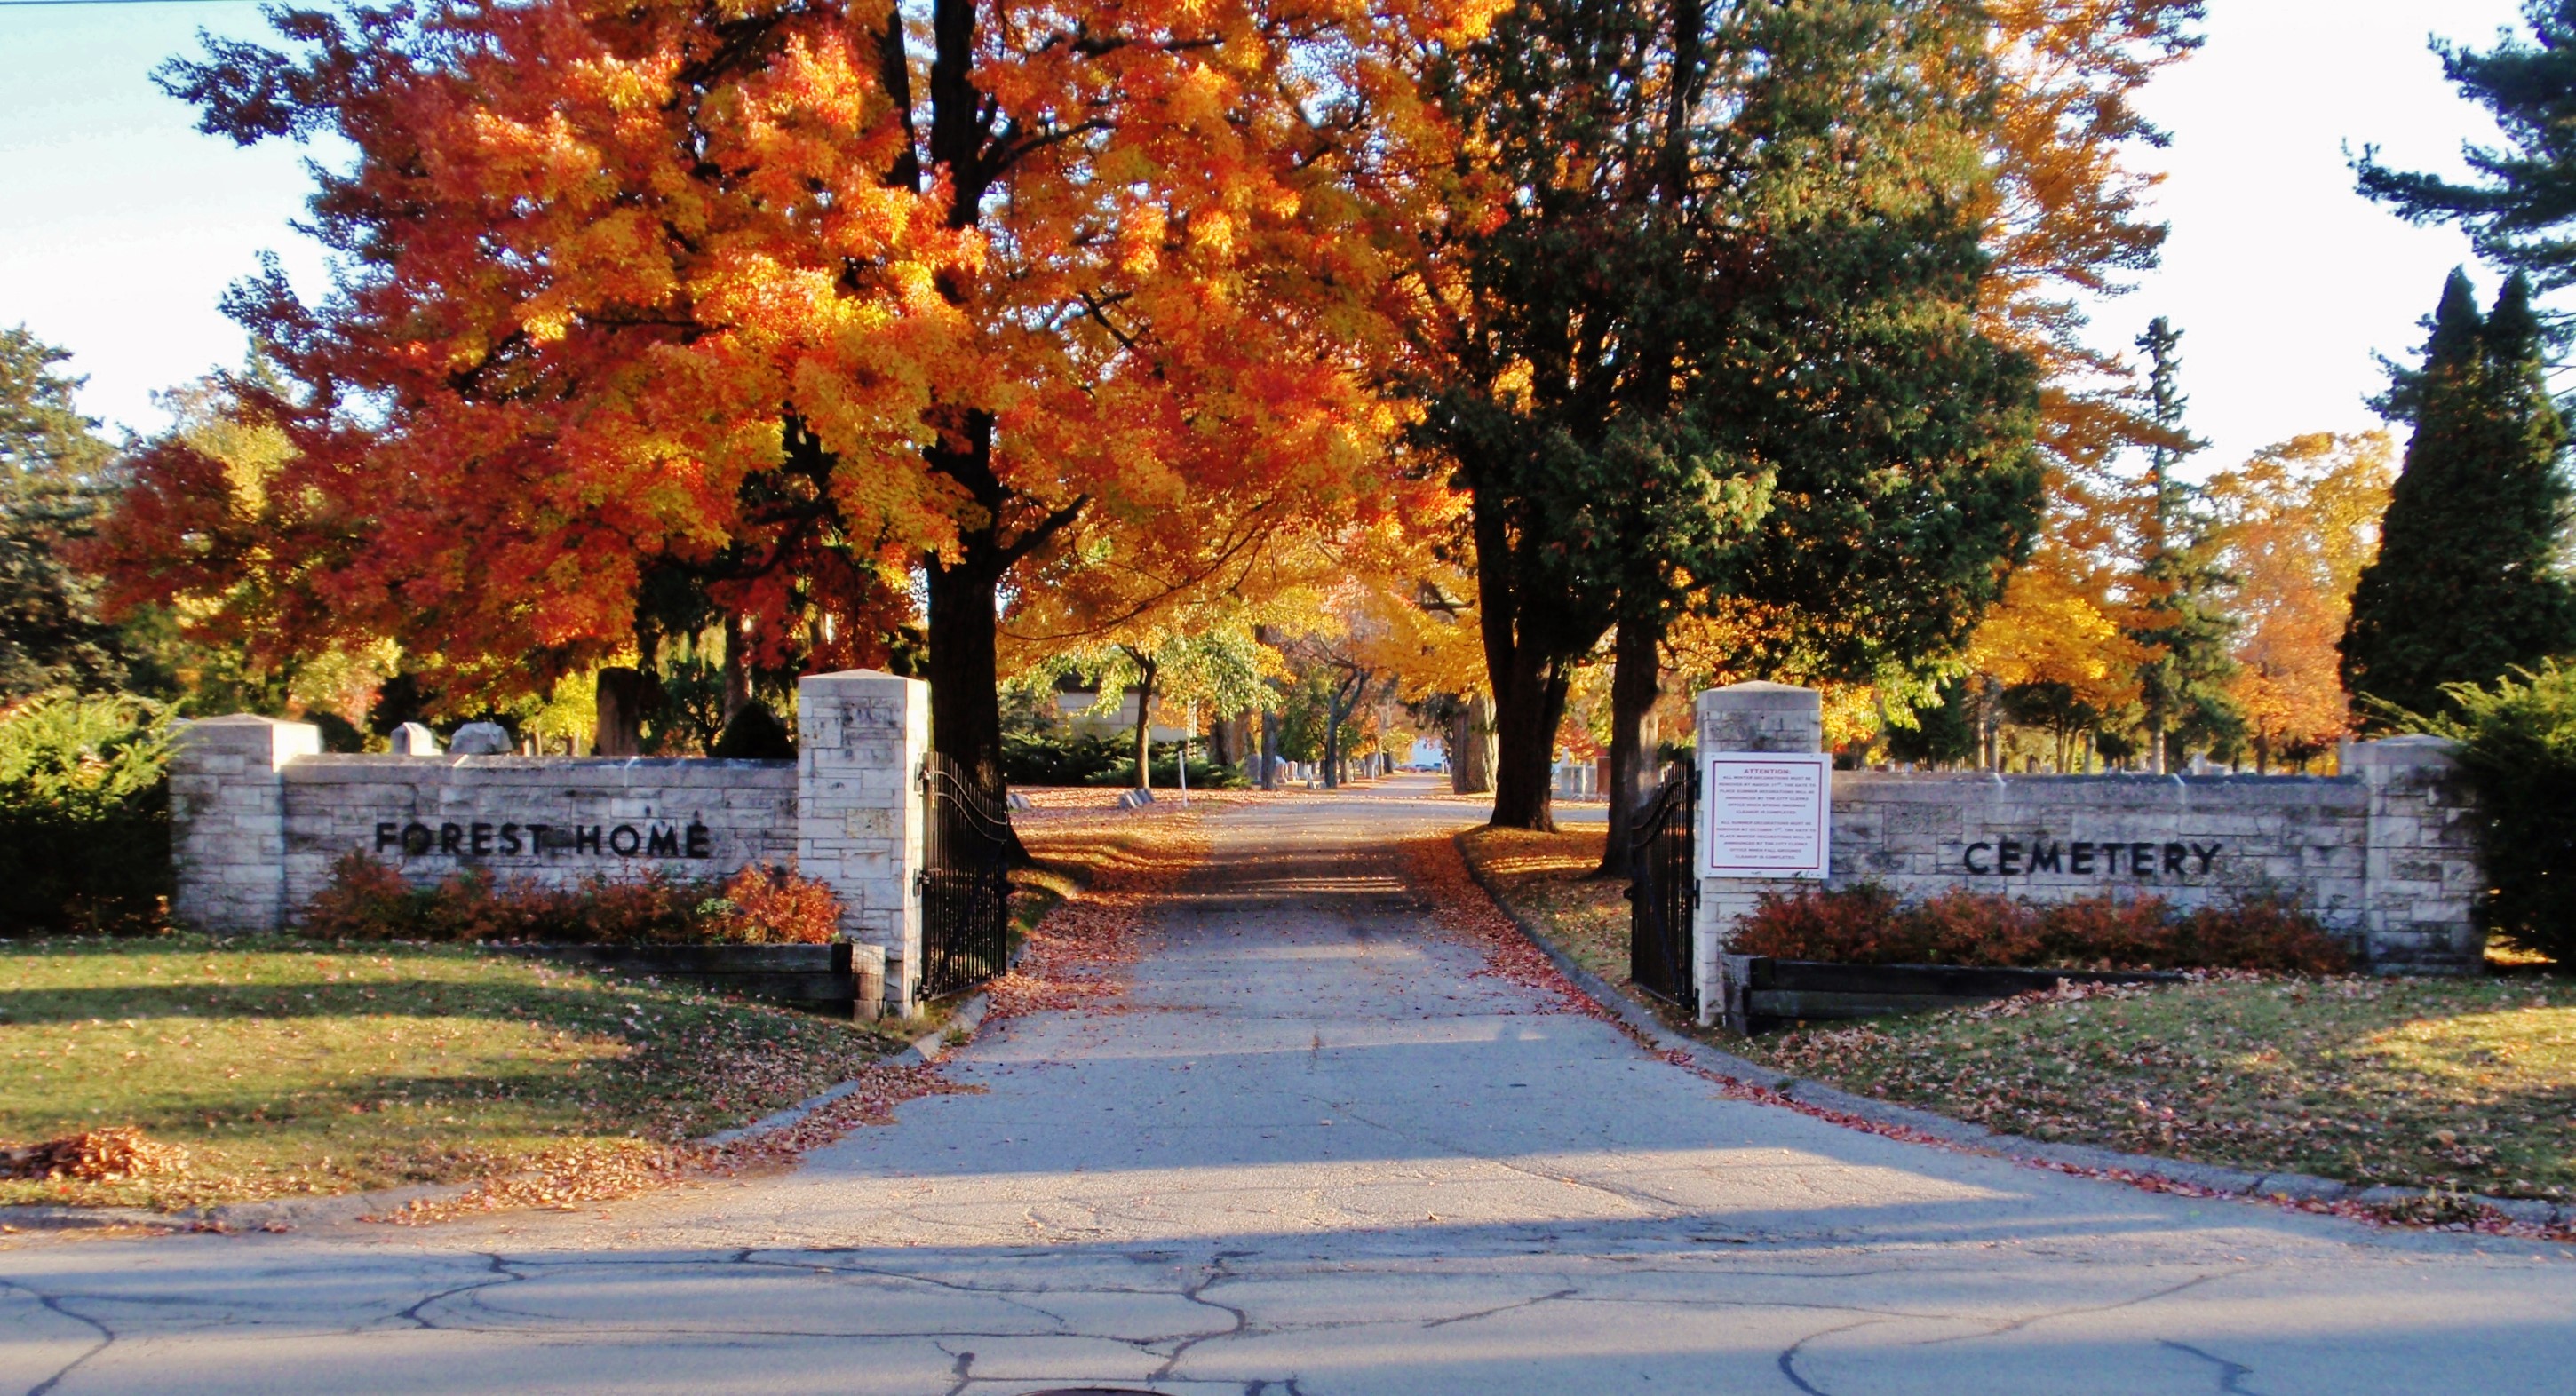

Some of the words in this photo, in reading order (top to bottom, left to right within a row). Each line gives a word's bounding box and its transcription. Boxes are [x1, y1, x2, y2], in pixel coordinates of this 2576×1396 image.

[376, 822, 547, 855] FOREST
[577, 824, 709, 857] HOME
[1963, 842, 2222, 875] CEMETERY
